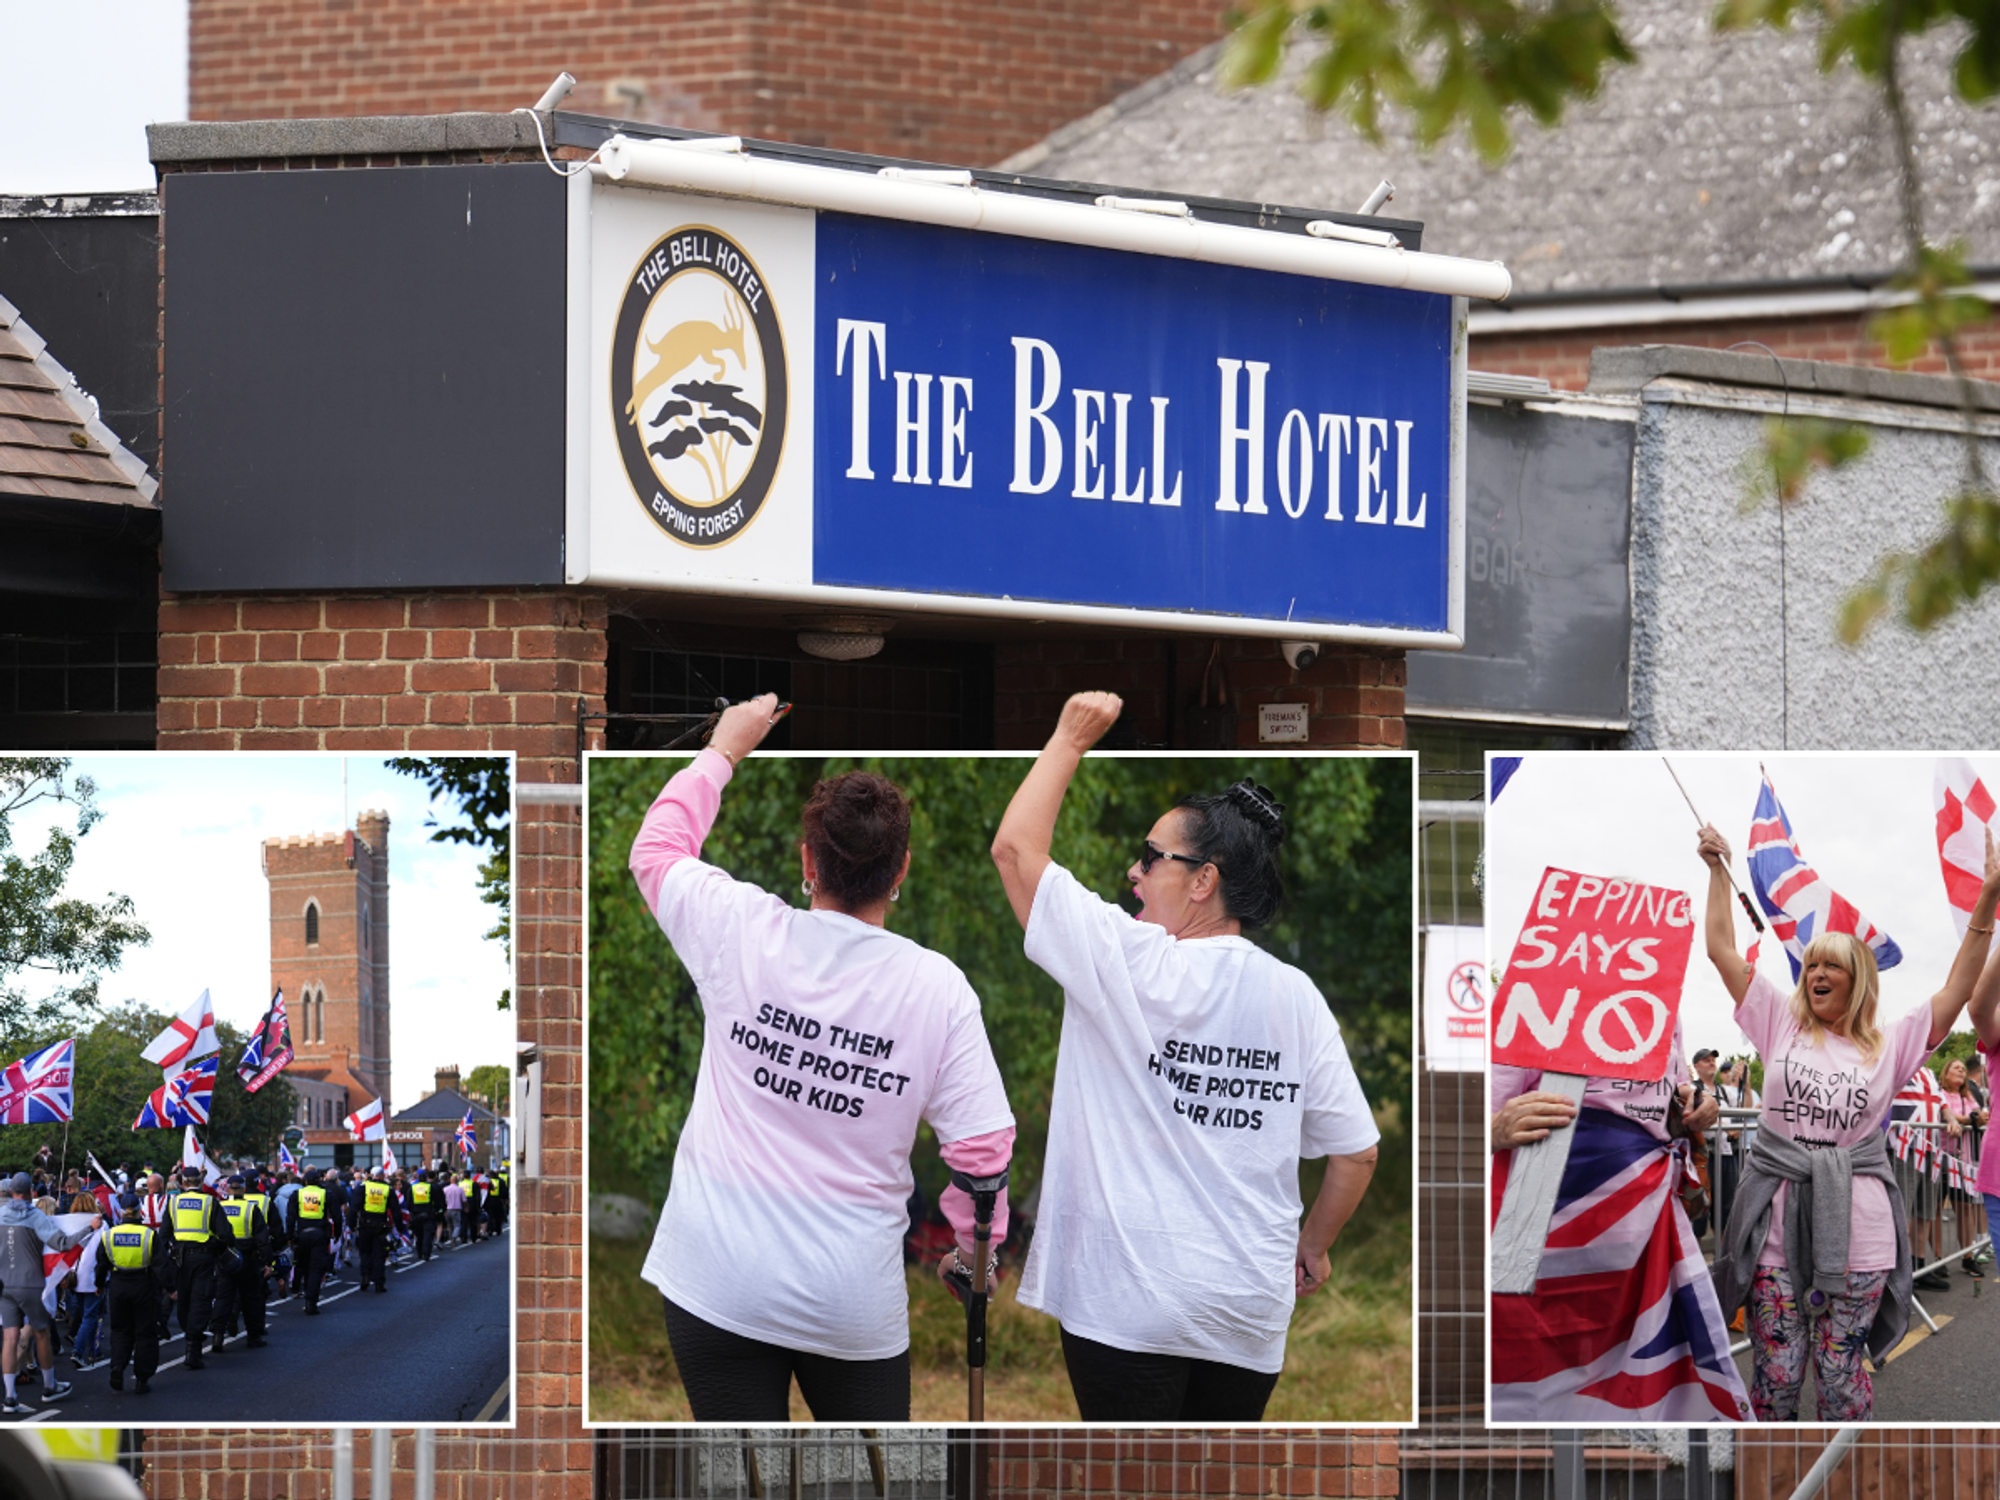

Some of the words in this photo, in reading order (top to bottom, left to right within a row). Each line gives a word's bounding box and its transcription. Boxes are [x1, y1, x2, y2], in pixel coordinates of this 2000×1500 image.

[636, 249, 670, 297] THE
[669, 235, 713, 268] BELL
[715, 242, 764, 314] HOTEL
[836, 318, 974, 488] THE
[1008, 335, 1182, 507] BELL
[1214, 356, 1427, 529] HOTEL
[651, 490, 696, 535] EPPING
[698, 499, 746, 537] FOREST
[1536, 870, 1692, 928] EPPING
[1511, 924, 1663, 981] SAYS
[756, 1003, 822, 1041] SEND
[829, 1024, 895, 1060] THEM
[1494, 981, 1671, 1065] NO
[730, 1020, 795, 1066] HOME
[797, 1050, 911, 1096] PROTECT
[1148, 1053, 1202, 1094] HME
[1205, 1076, 1301, 1103] PROTECT
[1161, 1039, 1223, 1066] SEND
[1226, 1046, 1281, 1071] THEM
[1782, 1060, 1823, 1085] THE
[753, 1066, 804, 1103] OUR
[806, 1086, 865, 1118] KIDS
[1785, 1060, 1839, 1106] WAY
[1846, 1088, 1870, 1110] IS
[1212, 1107, 1263, 1131] KIDS
[1773, 1101, 1863, 1131] EPPING
[114, 1233, 140, 1245] POLICE
